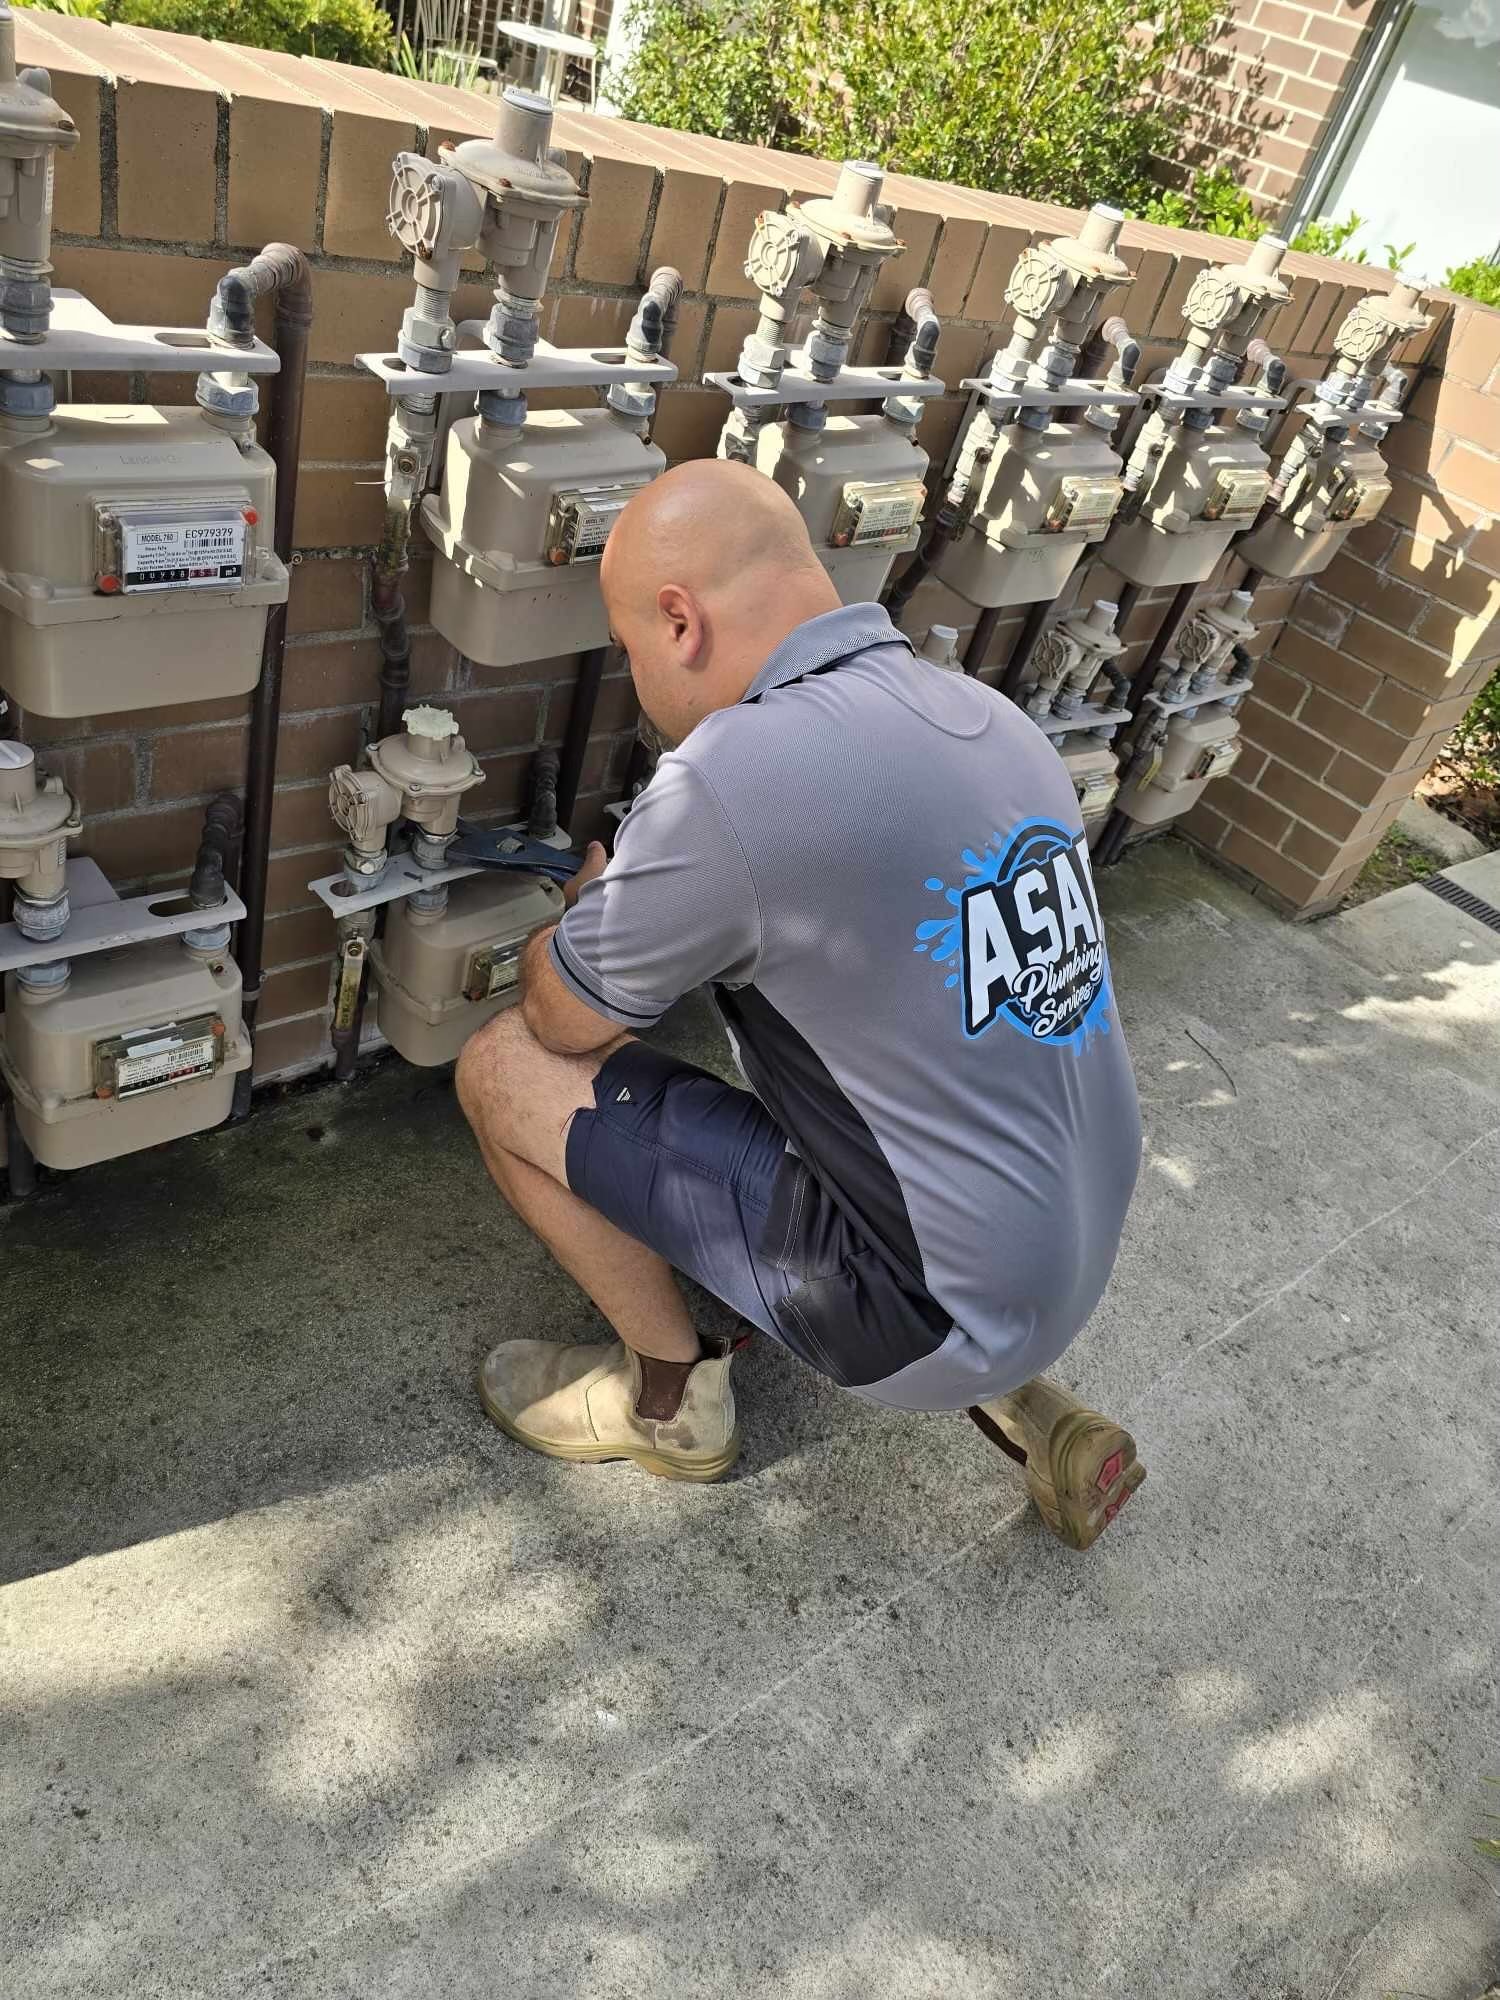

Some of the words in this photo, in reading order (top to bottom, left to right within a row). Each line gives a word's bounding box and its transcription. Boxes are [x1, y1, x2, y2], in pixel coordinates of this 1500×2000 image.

[141, 534, 163, 543] MODEL
[1014, 942, 1103, 1012] Plumbing
[1033, 984, 1094, 1037] Services
